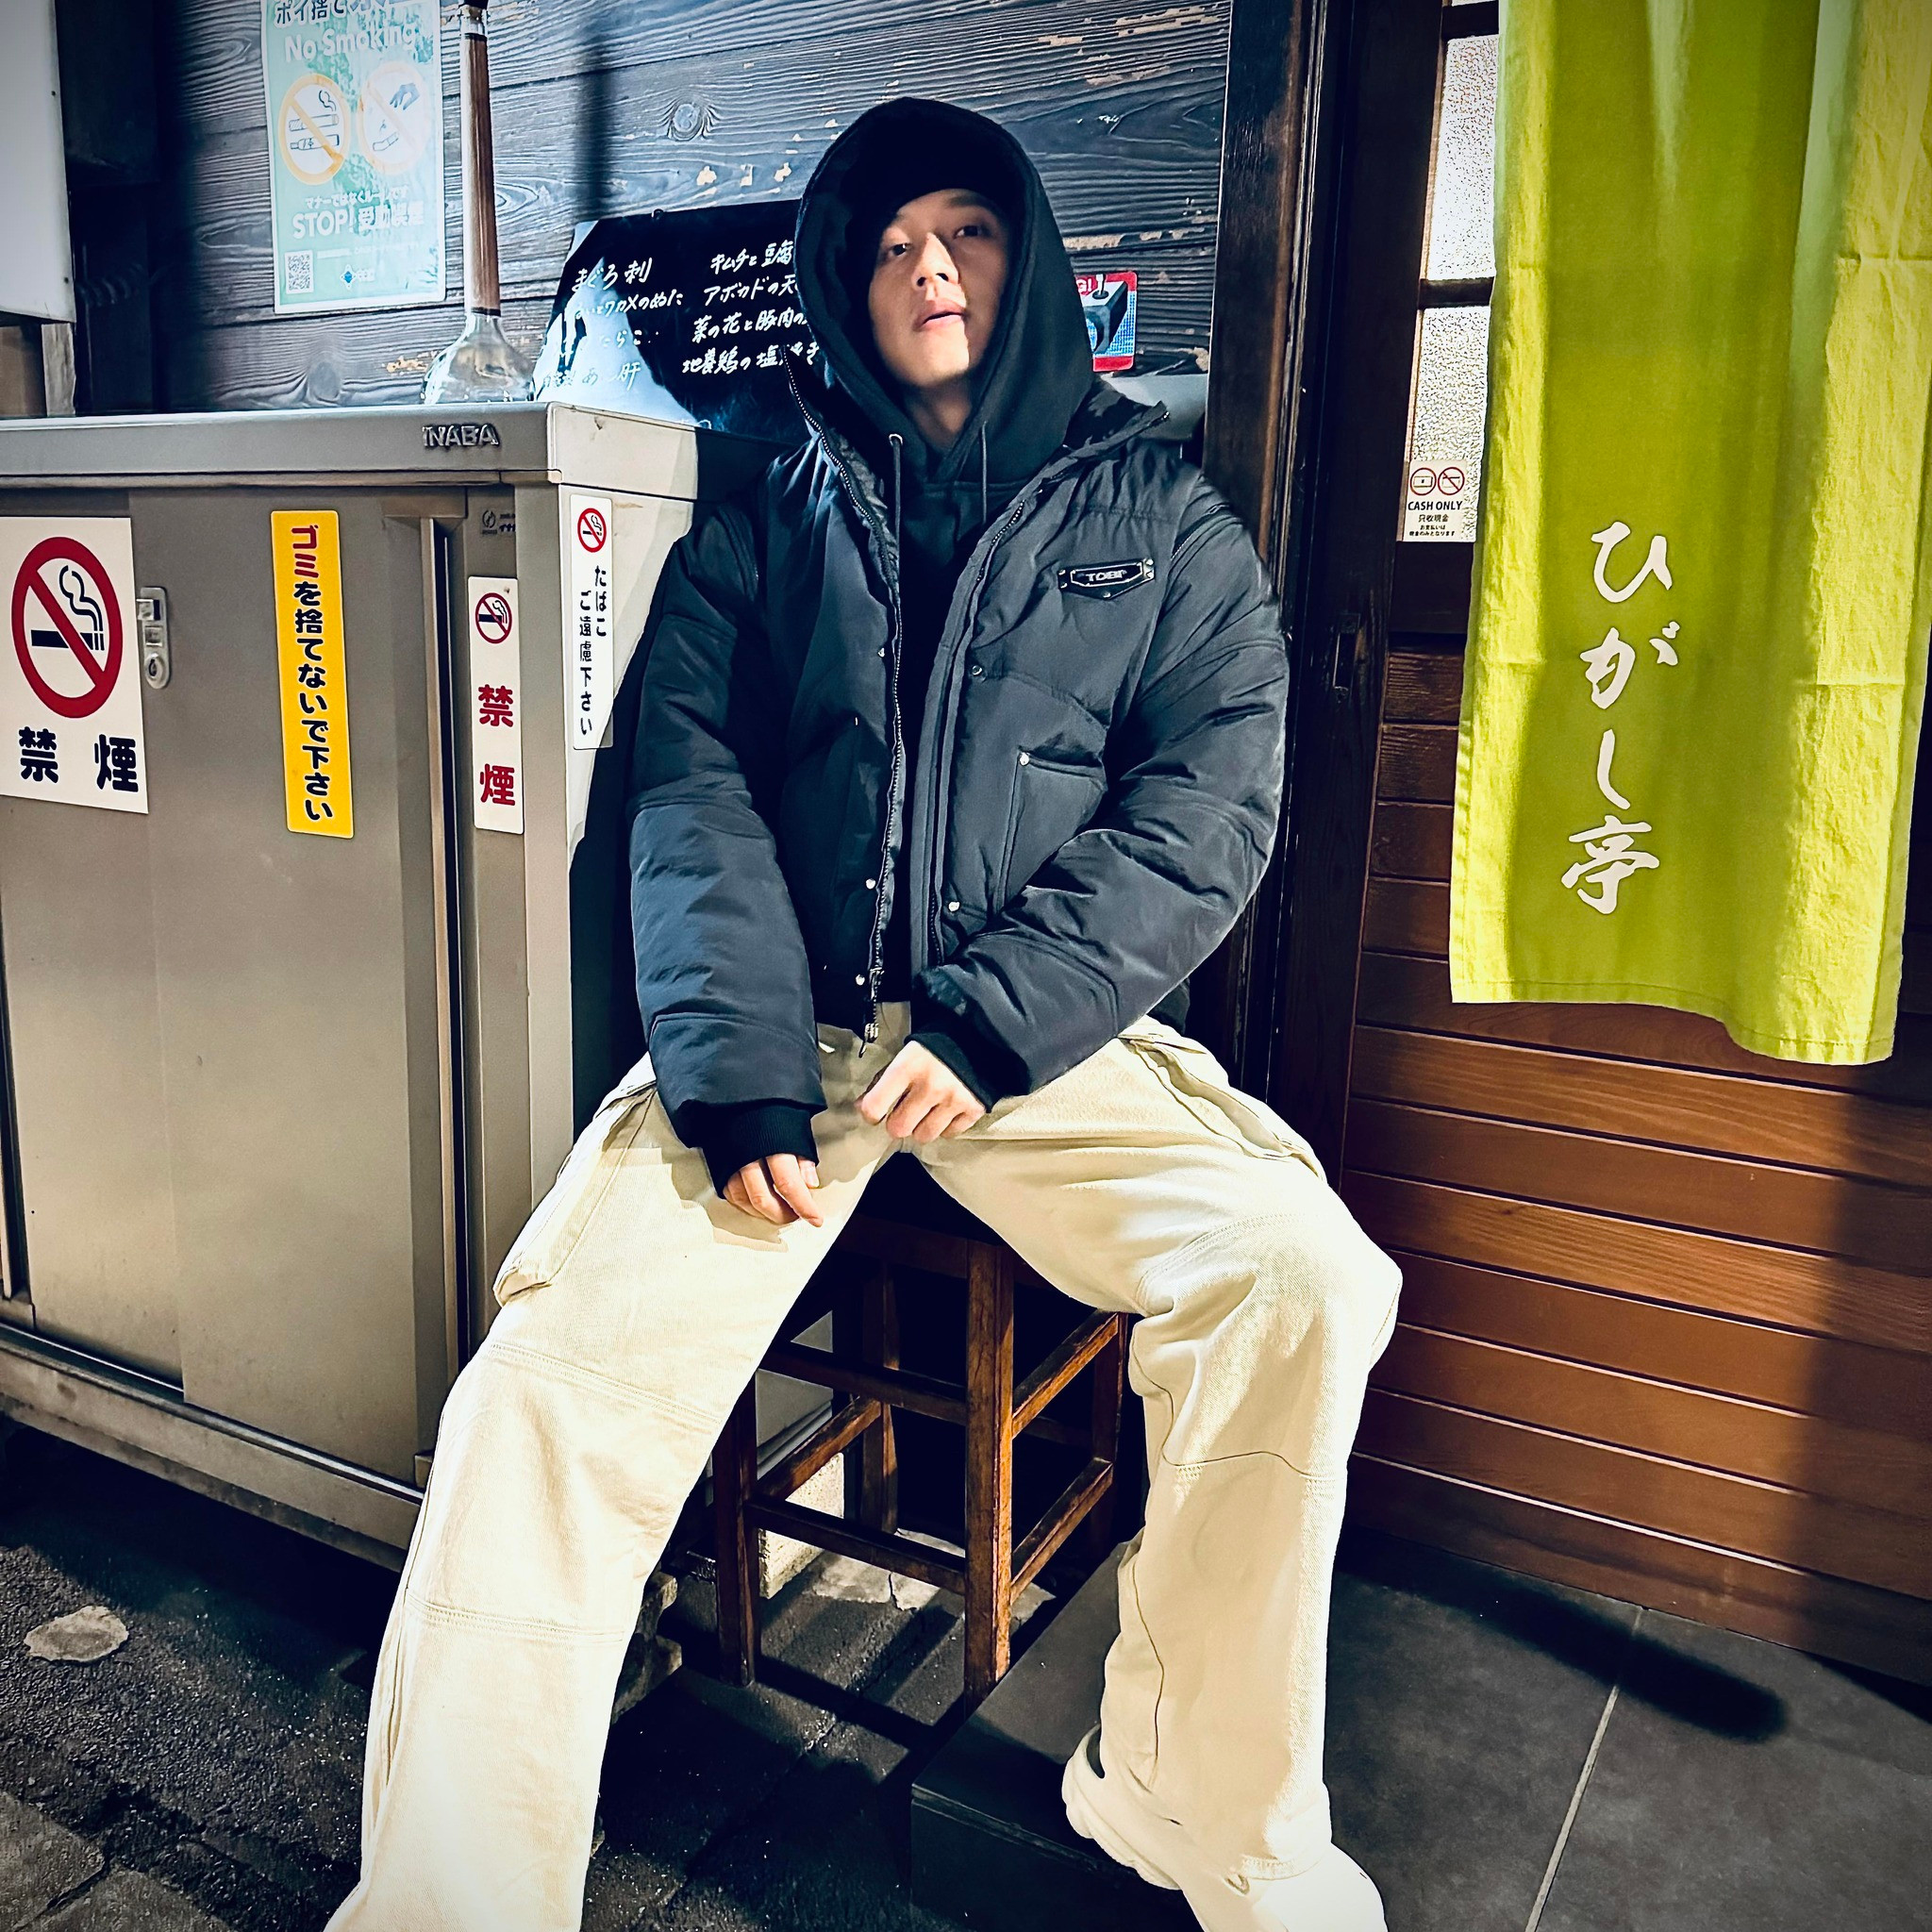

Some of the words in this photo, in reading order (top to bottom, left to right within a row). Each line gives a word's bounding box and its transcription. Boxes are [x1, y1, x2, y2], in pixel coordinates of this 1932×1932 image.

[285, 34, 317, 62] No
[322, 23, 416, 57] Smoking
[292, 206, 355, 239] STOP!
[710, 240, 793, 275] キムチと豆腐
[704, 275, 798, 307] アボカドの天
[691, 307, 808, 343] 菜の花と豚肉の
[1407, 501, 1433, 510] CASH
[1436, 501, 1463, 510] ONLY
[291, 525, 333, 821] ゴミを捨てないで下さい
[1561, 521, 1680, 915] ひがし亭
[19, 726, 139, 792] 禁煙
[477, 685, 516, 807] 禁煙
